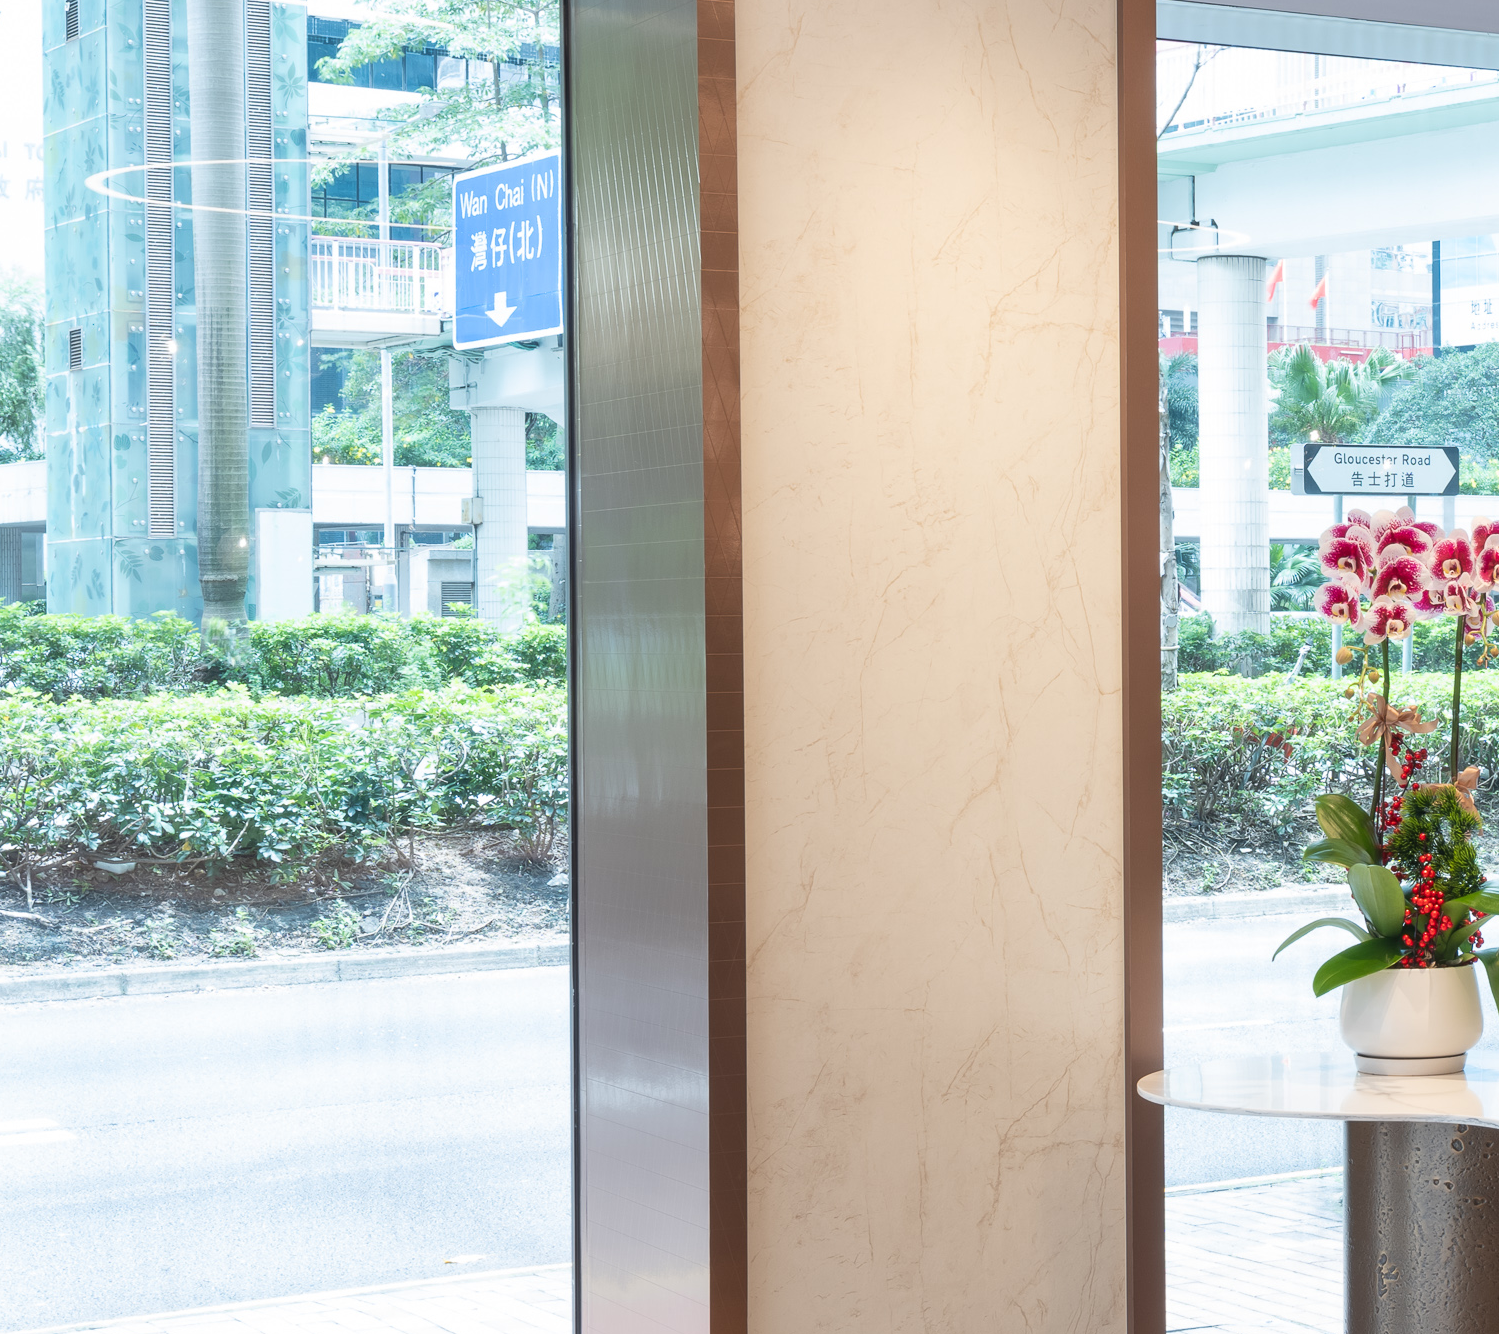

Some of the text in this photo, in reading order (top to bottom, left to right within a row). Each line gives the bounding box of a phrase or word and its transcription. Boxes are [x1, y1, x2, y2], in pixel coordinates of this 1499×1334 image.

[460, 169, 554, 219] Wan Chai (N)
[470, 215, 543, 272] 灣仔(北)
[1471, 298, 1493, 315] 地址
[1334, 452, 1431, 466] Gloucester Road
[1351, 471, 1415, 488] 告士打道
